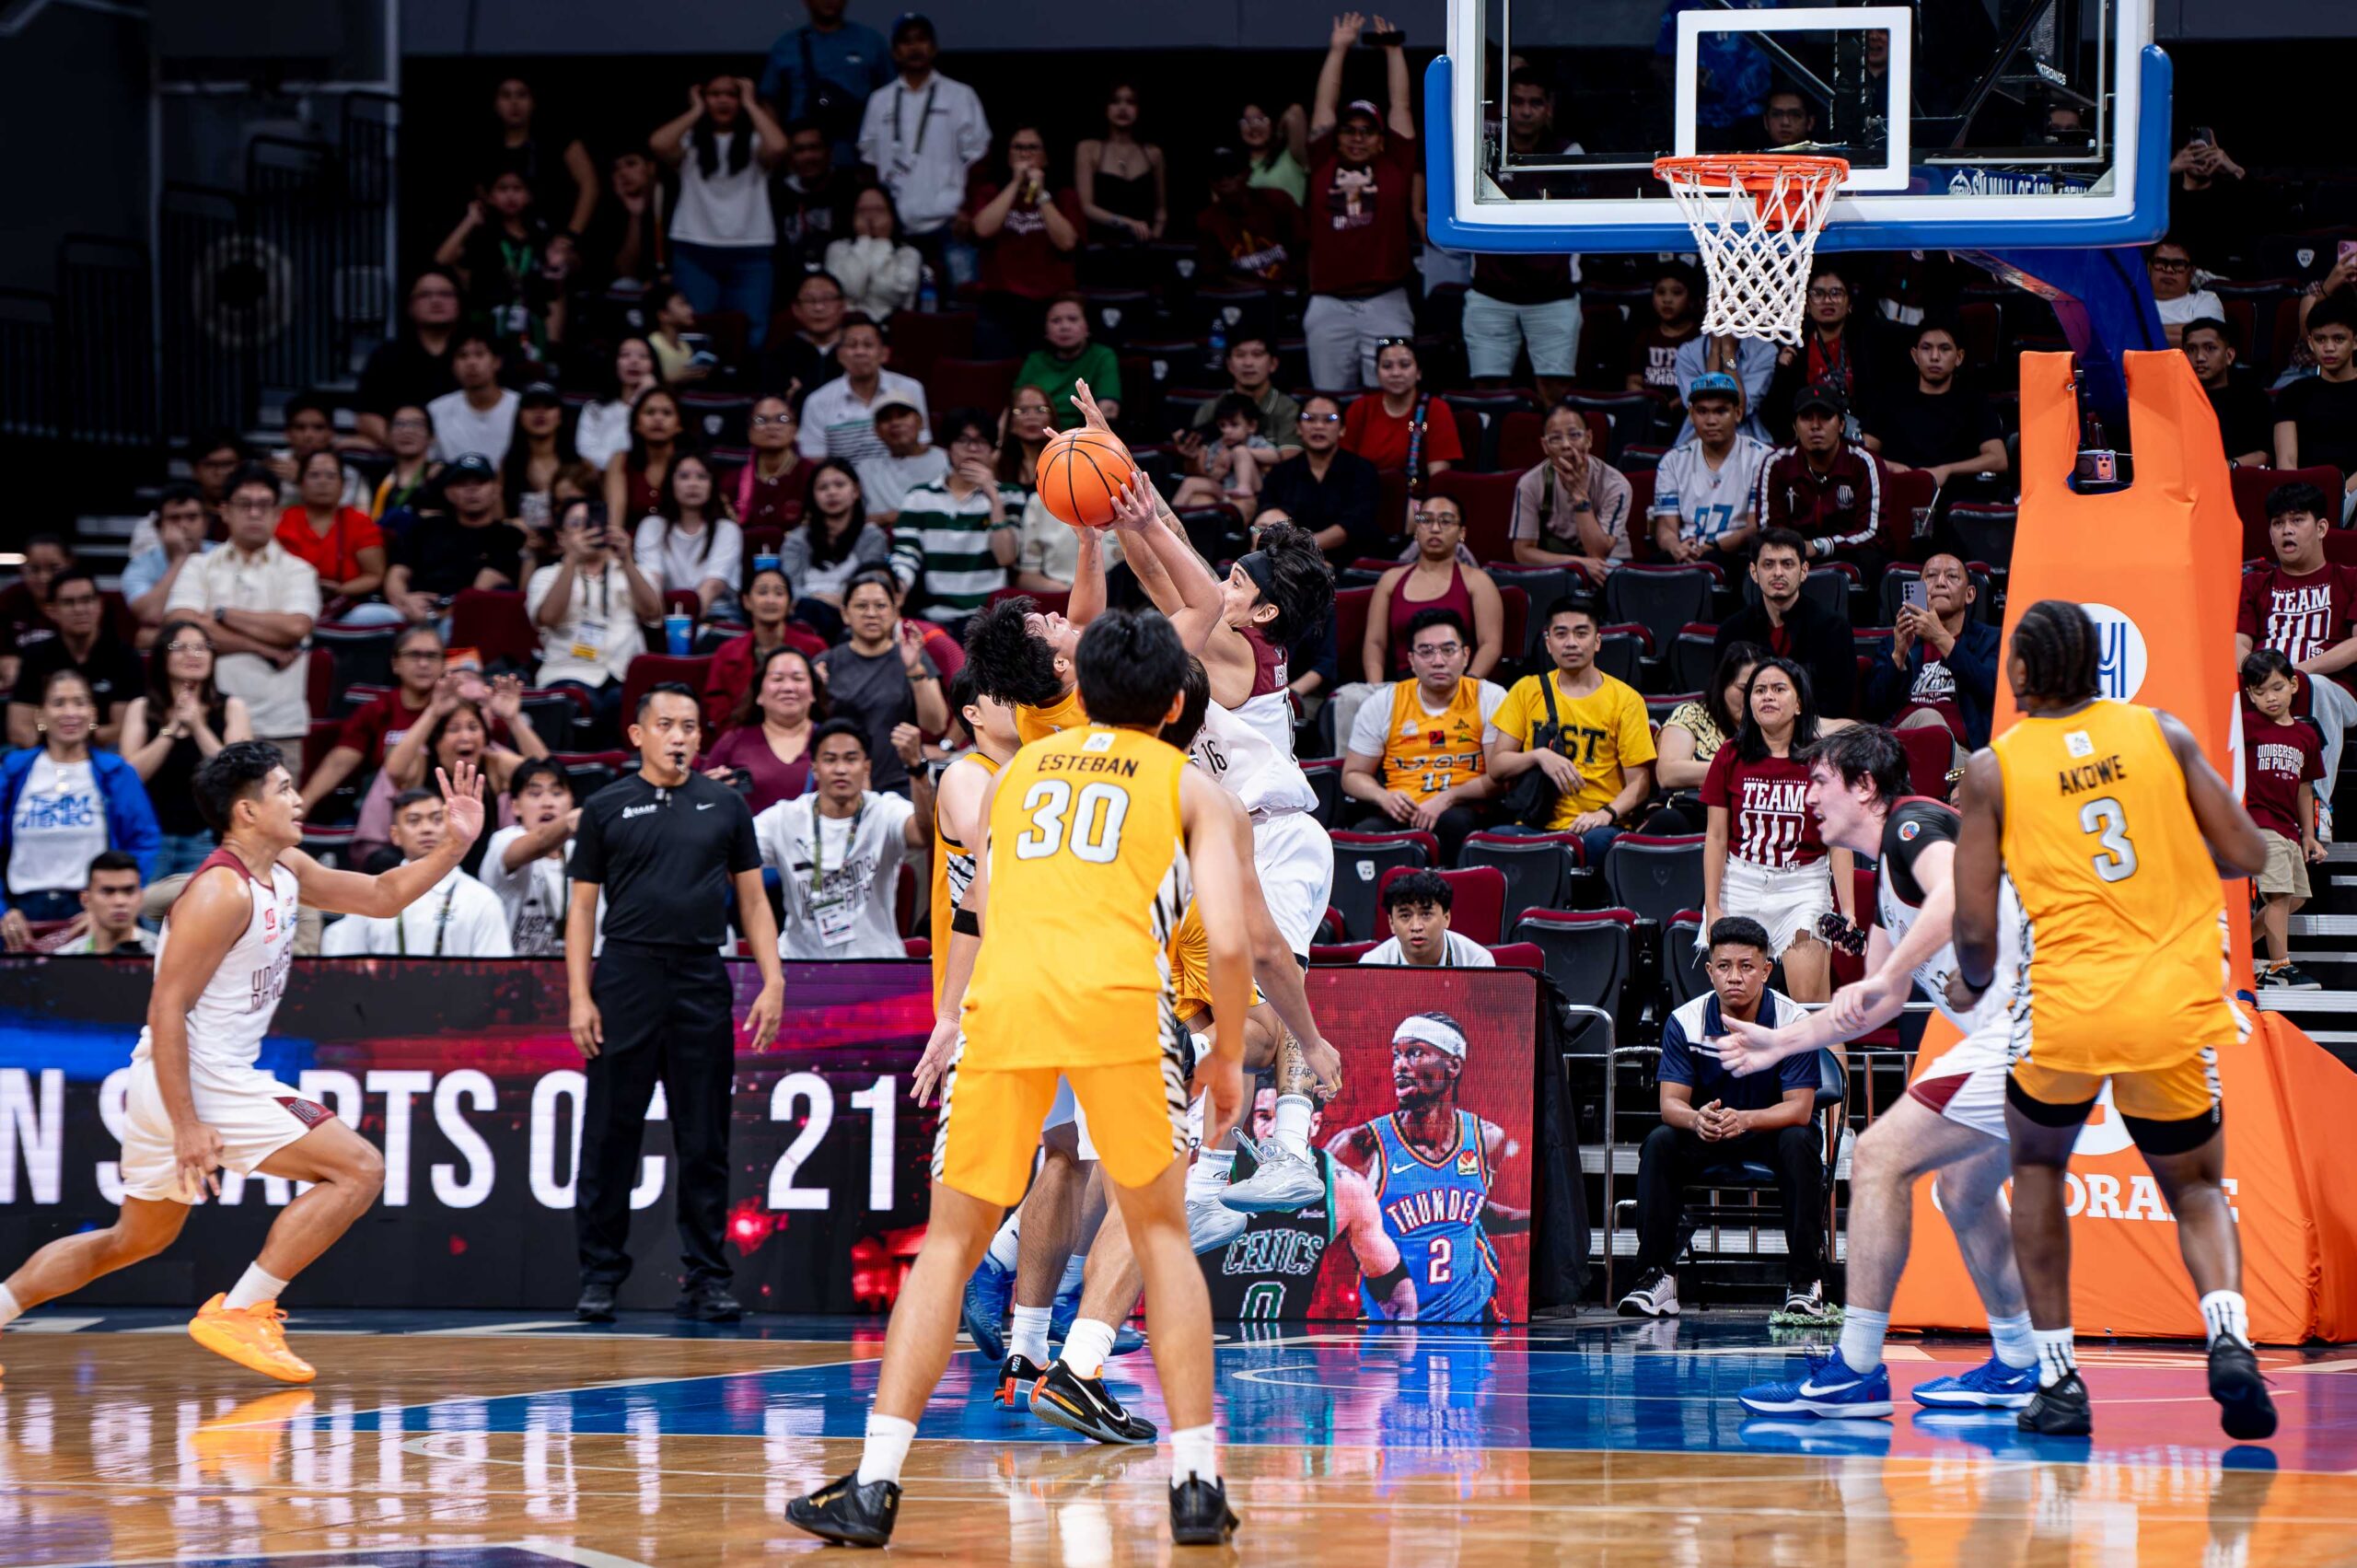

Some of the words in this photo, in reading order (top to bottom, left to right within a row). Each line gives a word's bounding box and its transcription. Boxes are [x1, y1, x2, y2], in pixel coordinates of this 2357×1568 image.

[2271, 585, 2331, 613] TEAM
[1038, 753, 1139, 778] ESTEBAN
[1201, 739, 1228, 775] 16
[2058, 754, 2128, 797] AKOWE
[1420, 772, 1453, 793] 11
[1742, 782, 1806, 813] TEAM
[1016, 778, 1131, 865] 30
[2079, 796, 2139, 884] 3
[767, 1072, 897, 1211] 21
[1222, 1229, 1325, 1276] CELTICS
[1428, 1236, 1453, 1284] 2
